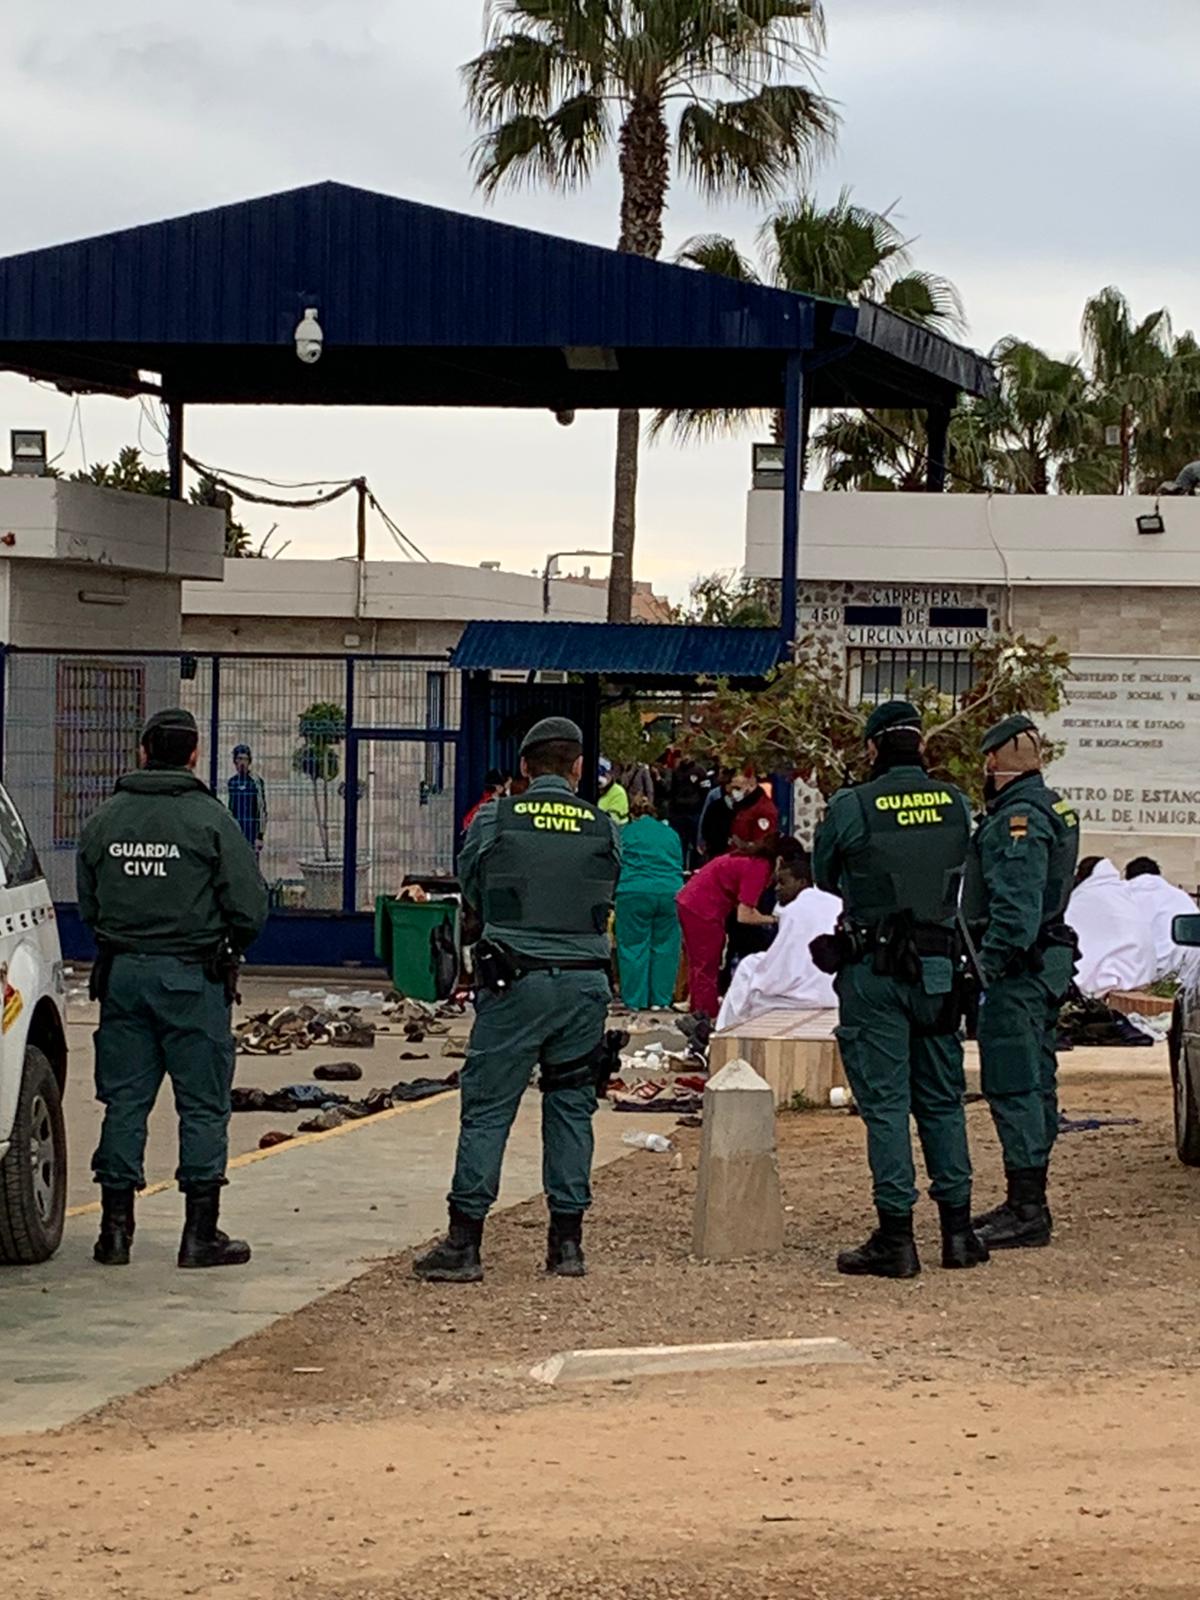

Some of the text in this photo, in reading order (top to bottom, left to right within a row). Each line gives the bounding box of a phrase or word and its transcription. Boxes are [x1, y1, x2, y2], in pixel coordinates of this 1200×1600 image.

[906, 609, 924, 624] DE
[1122, 673, 1135, 682] DE
[1127, 691, 1163, 701] SOCIAL
[1170, 691, 1178, 700] Y
[1126, 719, 1139, 729] DE
[1144, 720, 1185, 729] ESTADO
[1079, 739, 1092, 748] DE
[876, 791, 953, 810] GUARDIA
[1113, 788, 1134, 801] DE
[514, 802, 596, 821] GUARDIA
[897, 808, 943, 825] CIVIL
[1112, 808, 1133, 822] DE
[533, 815, 581, 832] CIVIL
[109, 842, 180, 858] GUARDIA
[124, 861, 167, 876] CIVIL
